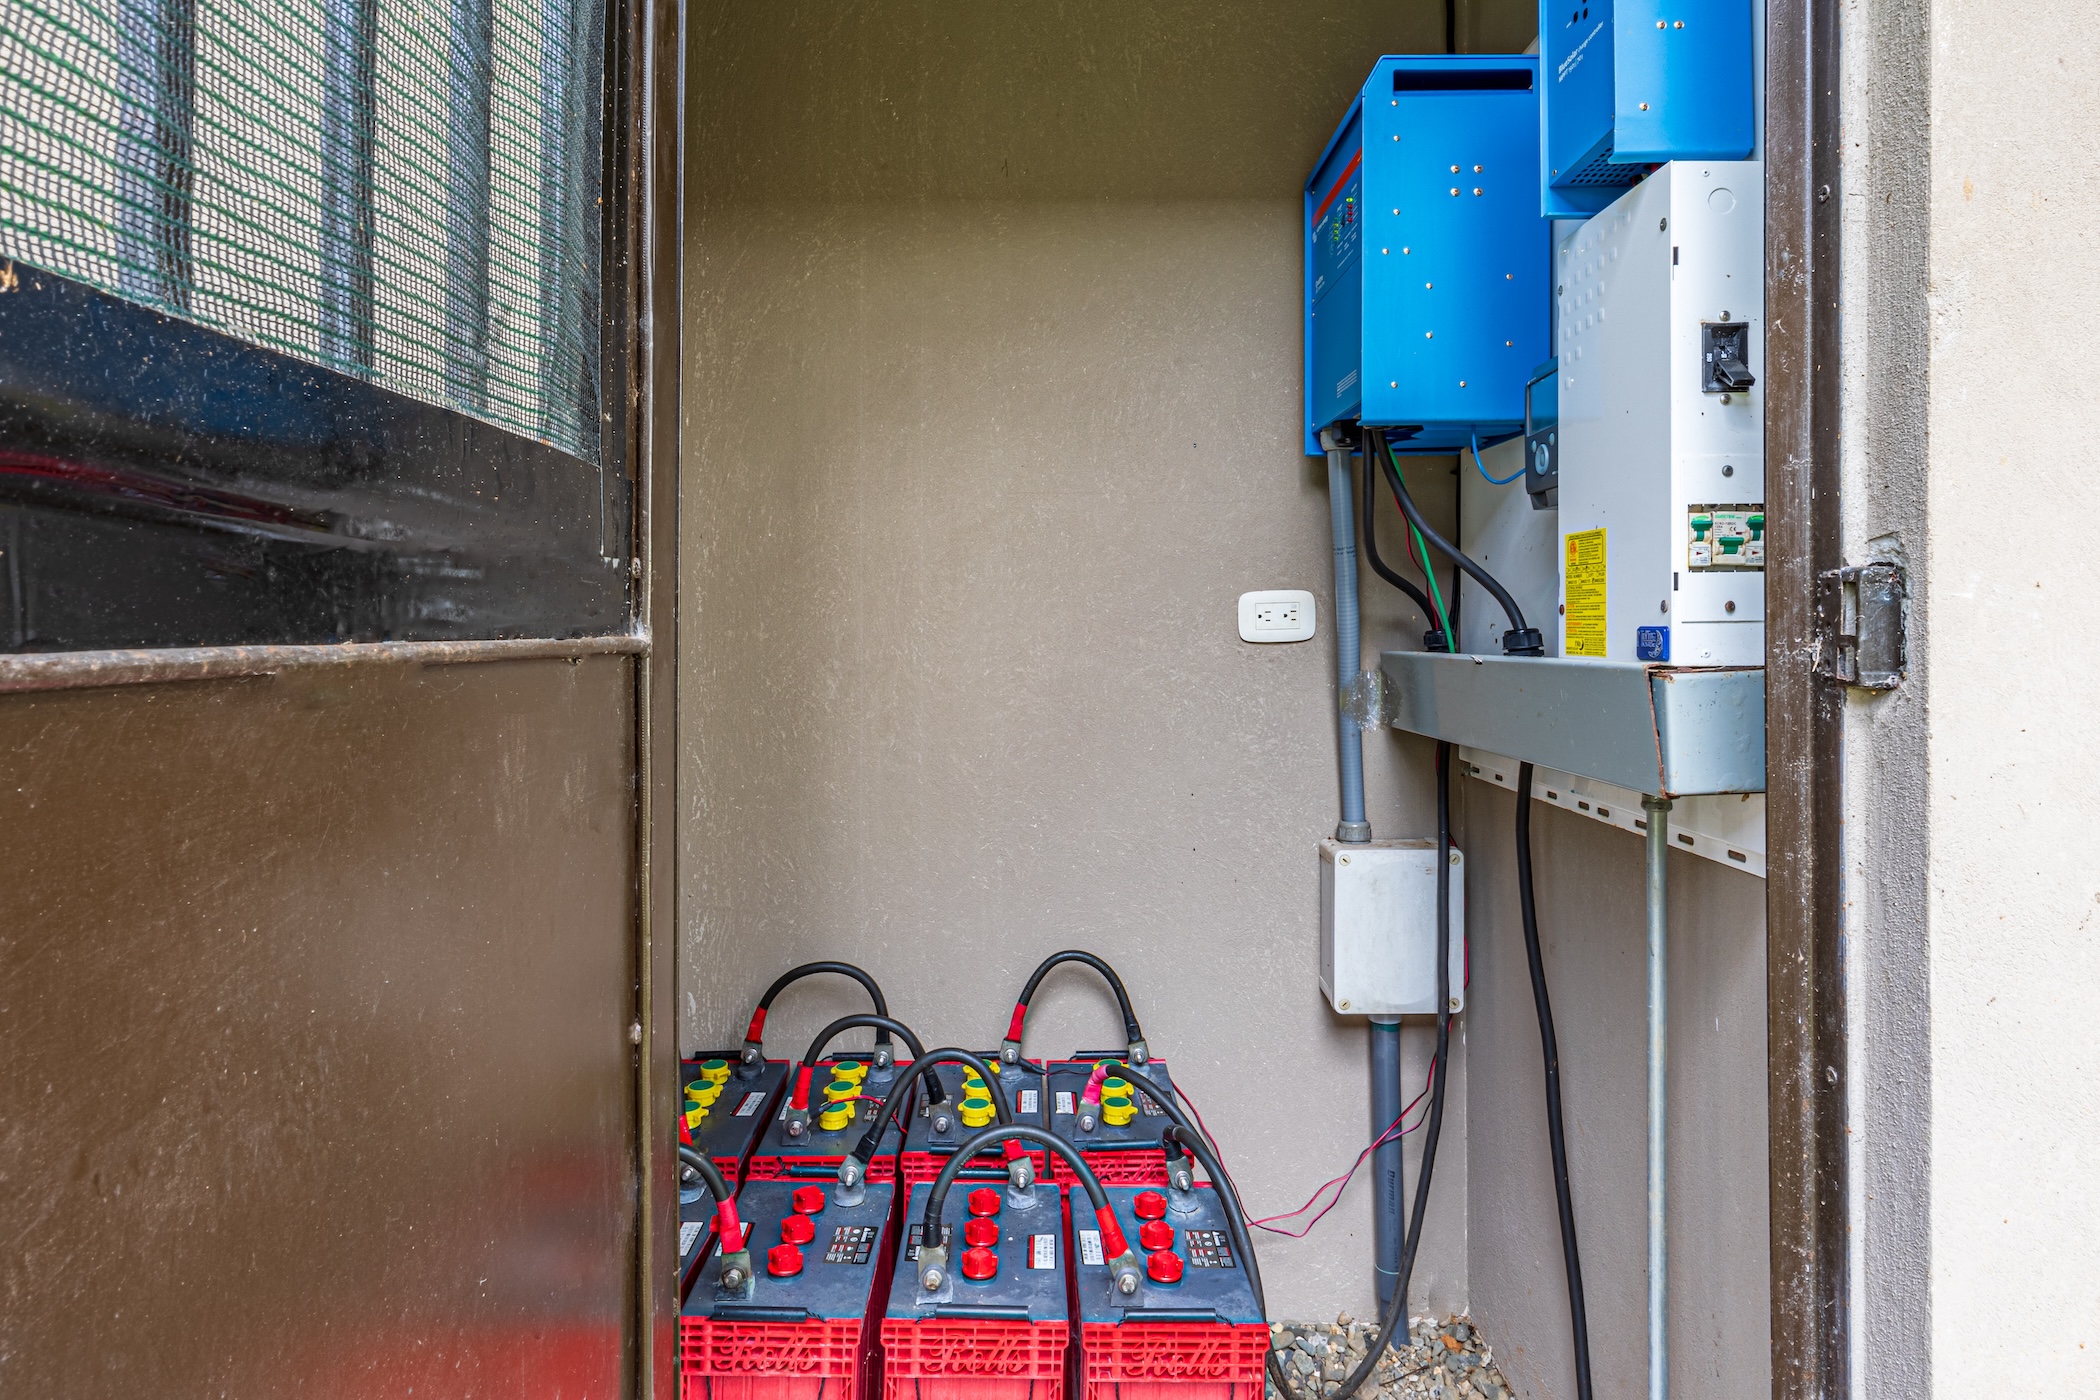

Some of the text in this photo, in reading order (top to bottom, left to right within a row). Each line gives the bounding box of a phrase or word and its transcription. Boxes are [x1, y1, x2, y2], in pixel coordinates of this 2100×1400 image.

[1387, 1169, 1395, 1215] Durman
[714, 1329, 817, 1371] Rolls
[924, 1333, 1027, 1373] Rolls
[1125, 1336, 1229, 1376] Rolls
